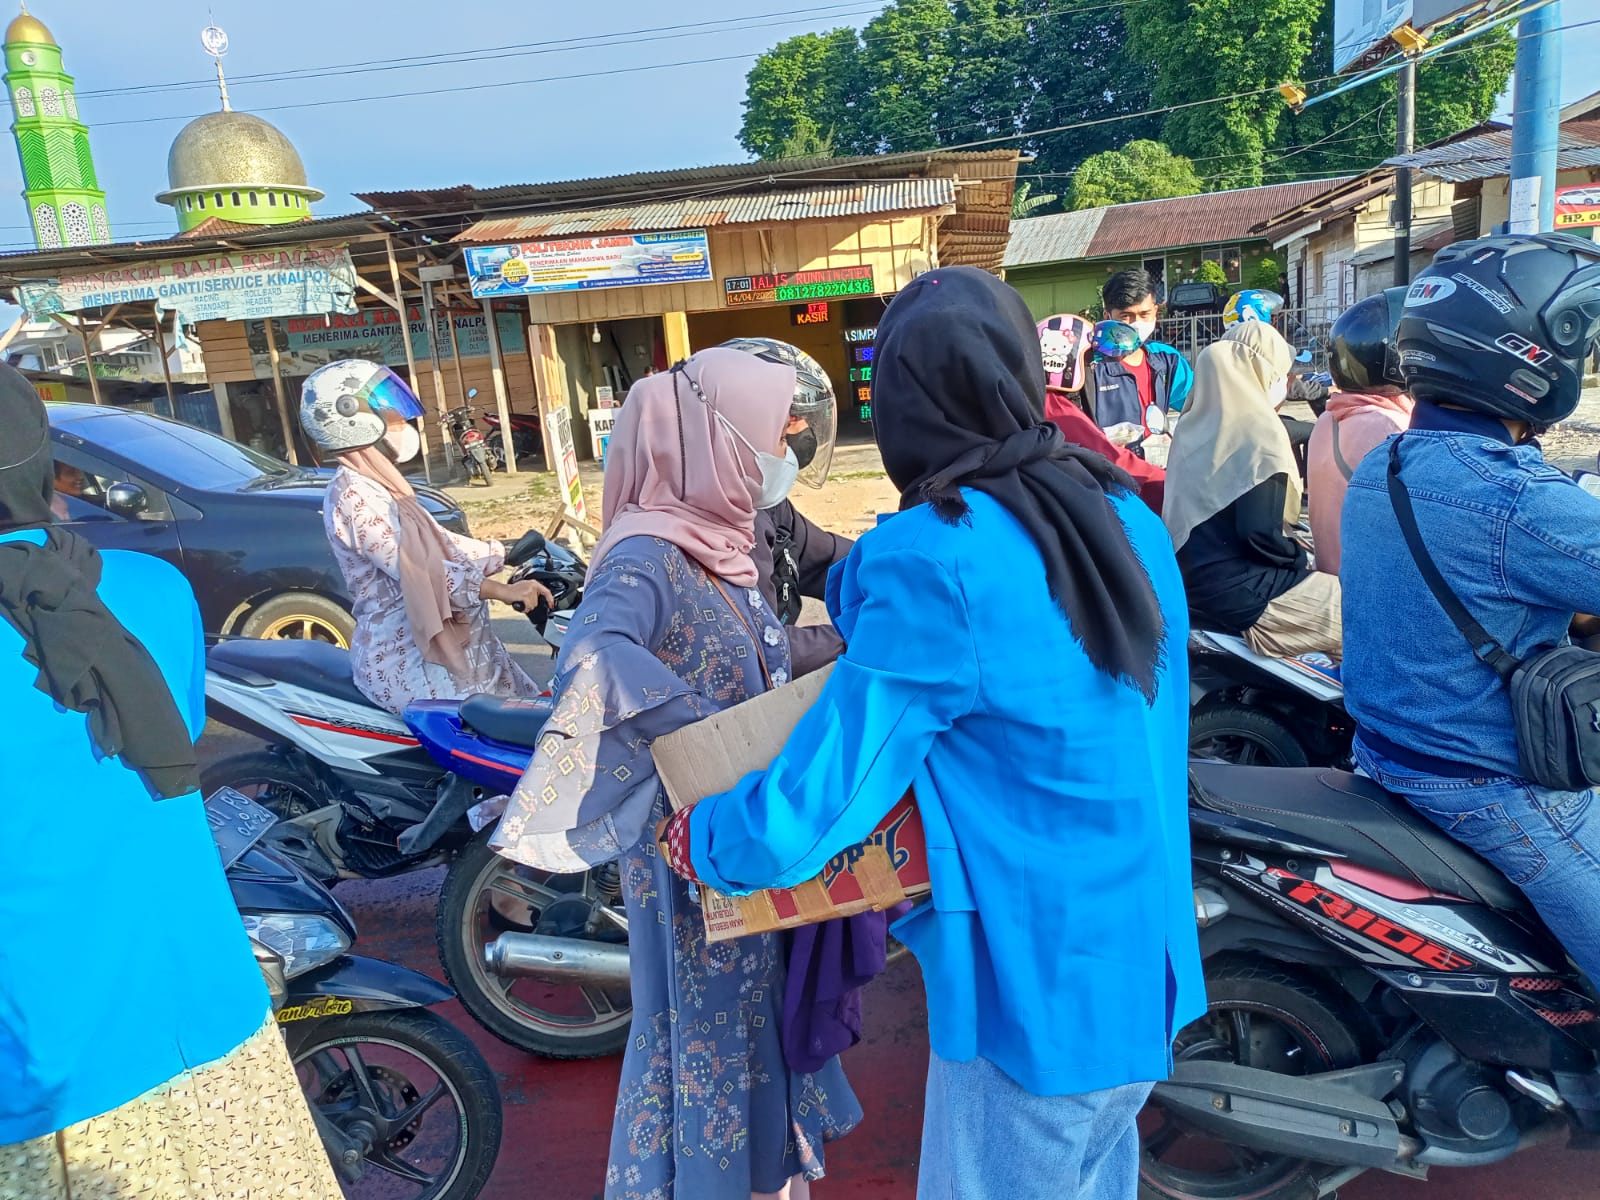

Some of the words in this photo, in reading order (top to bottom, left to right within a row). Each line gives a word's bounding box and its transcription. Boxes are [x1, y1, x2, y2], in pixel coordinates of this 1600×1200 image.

[521, 239, 594, 255] POLITEKNIK
[172, 256, 235, 279] RAJA
[81, 286, 155, 308] MENERIMA
[159, 274, 263, 297] GANTI/SERVICE
[729, 291, 774, 302] 14/04/2022
[779, 280, 871, 300] 081278220436
[1408, 283, 1442, 299] GM
[373, 306, 422, 325] RAA
[797, 311, 829, 324] KASIR
[303, 330, 360, 344] MENERIMA
[1496, 333, 1552, 366] GM
[1271, 898, 1347, 942] TECHNOLOGY
[1288, 880, 1475, 972] RIDE
